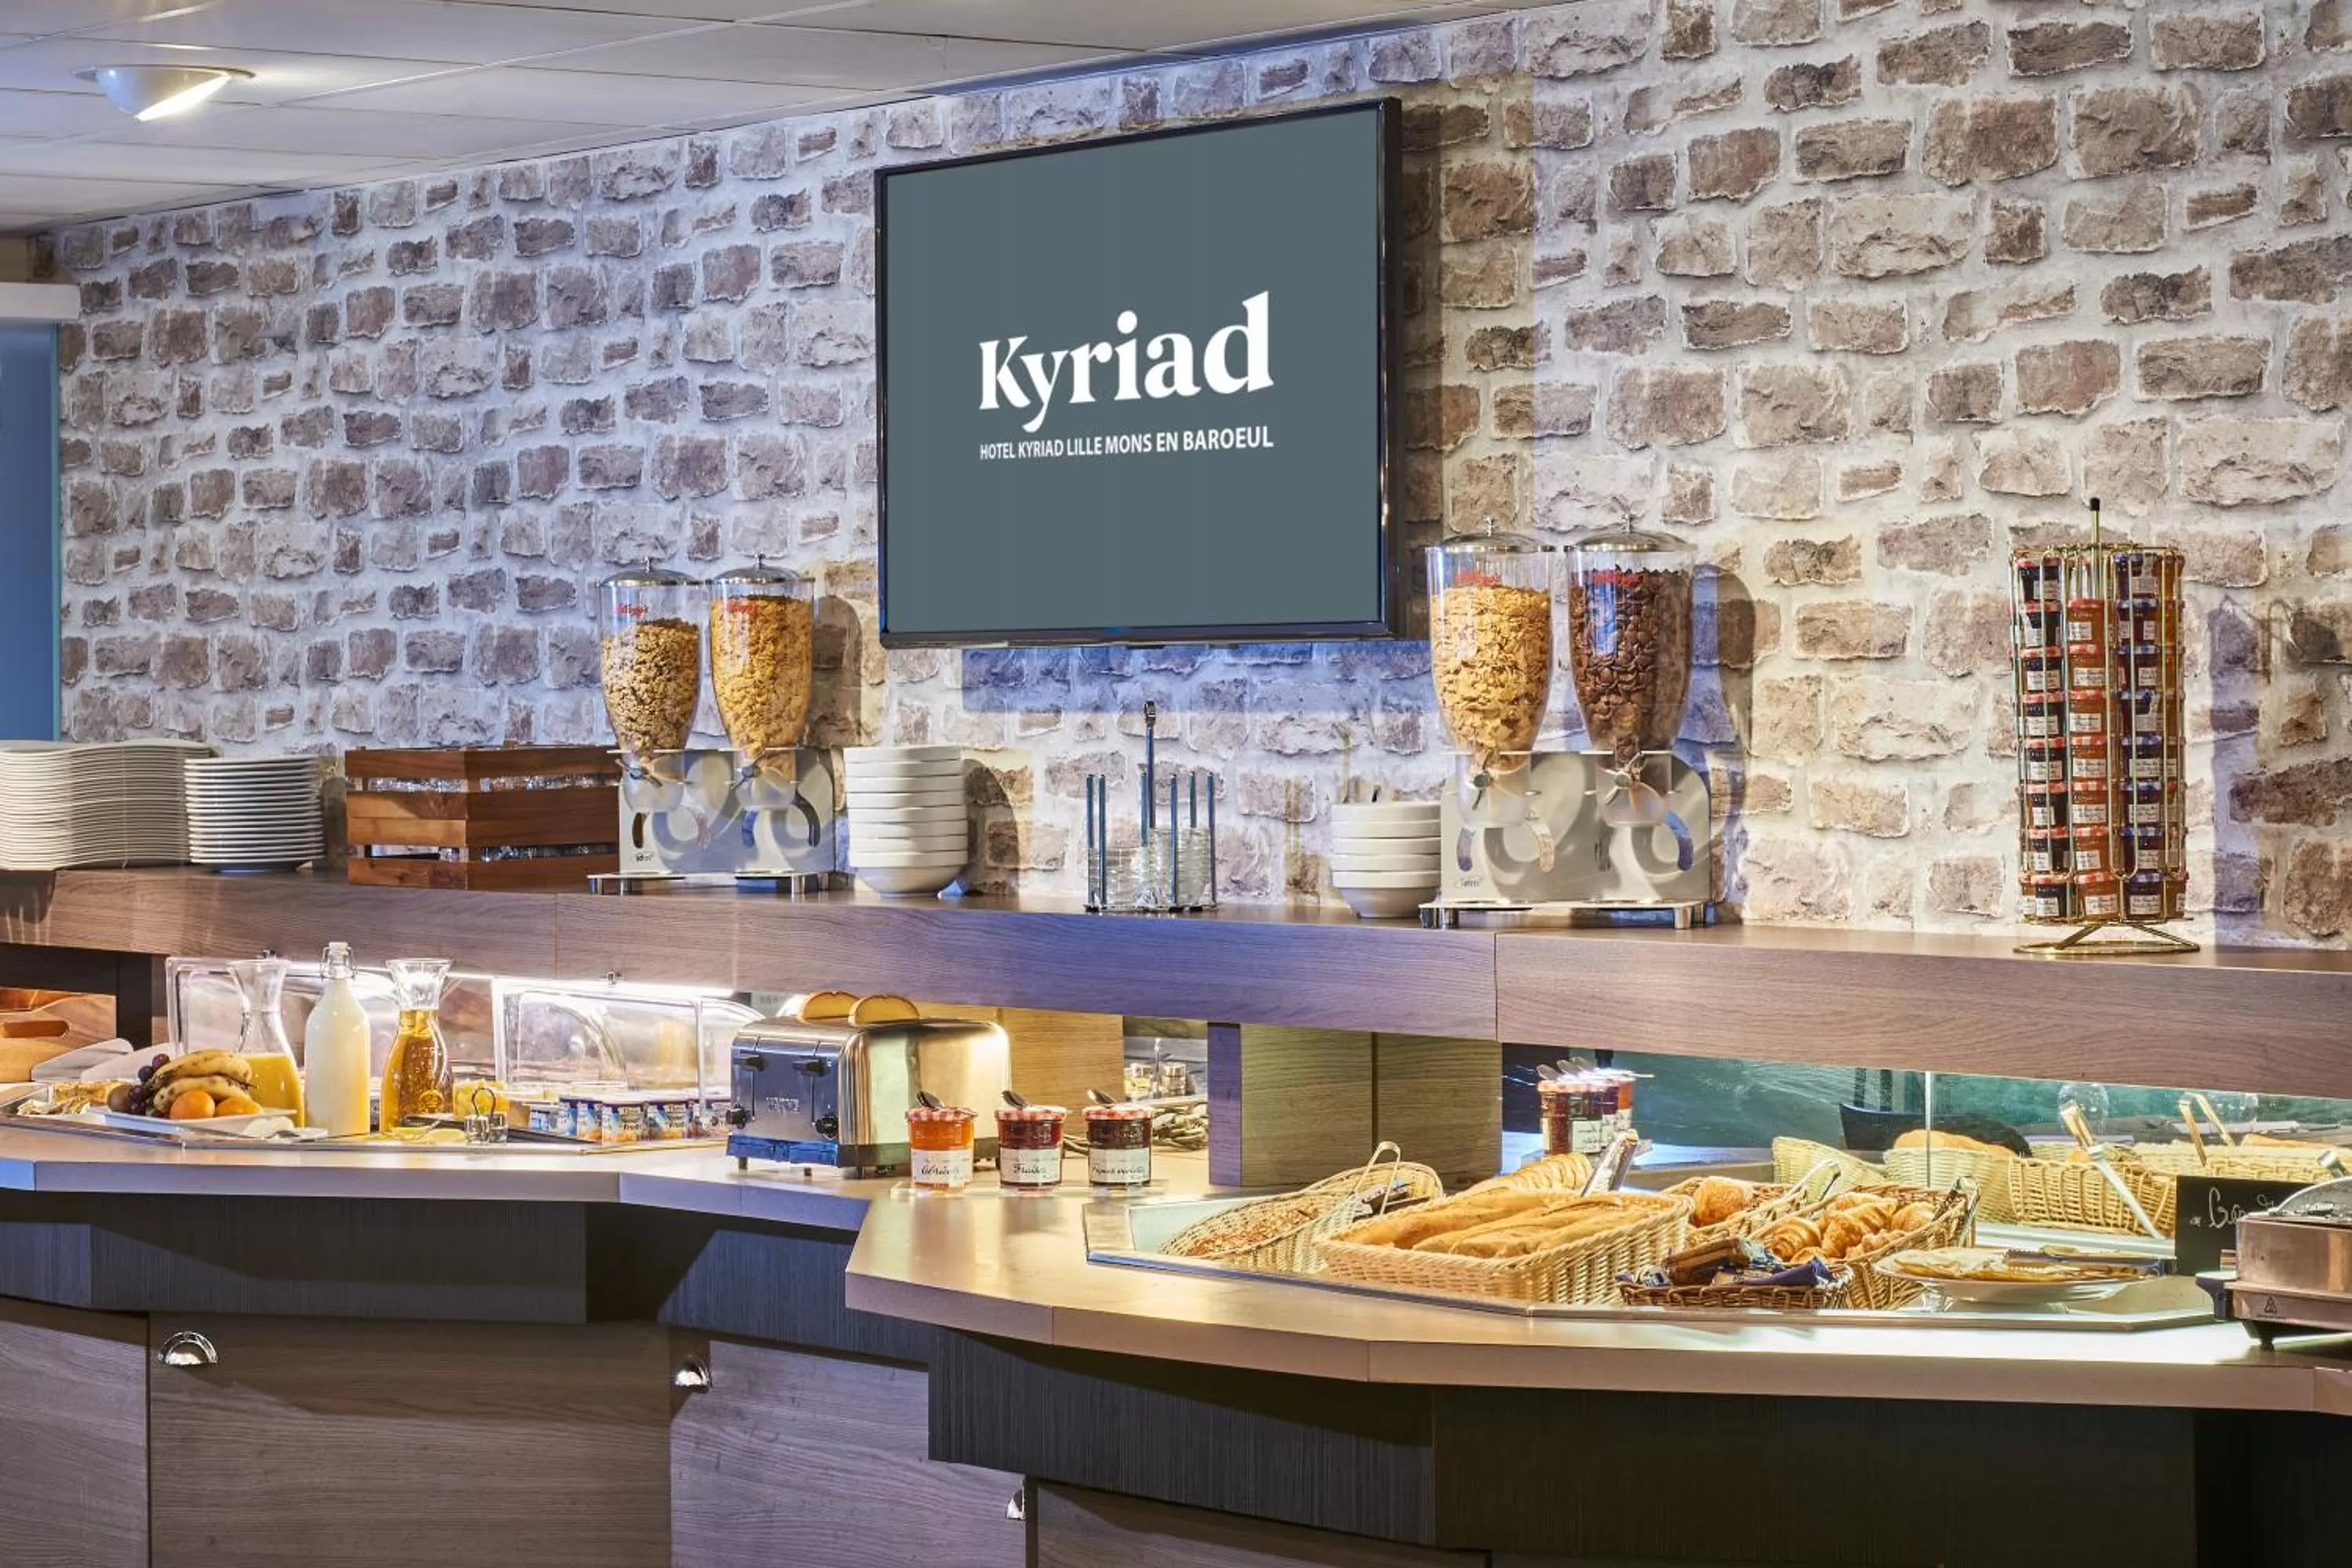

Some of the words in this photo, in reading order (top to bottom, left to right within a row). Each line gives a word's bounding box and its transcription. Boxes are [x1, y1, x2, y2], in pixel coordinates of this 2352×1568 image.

[979, 290, 1275, 434] Kyriad
[980, 443, 1015, 459] HOTEL
[1018, 438, 1064, 459] KYRIAD
[1067, 436, 1102, 456] LILLE
[1105, 433, 1152, 454] MONS
[1156, 431, 1178, 452] EN
[1183, 426, 1274, 451] BAROEUL
